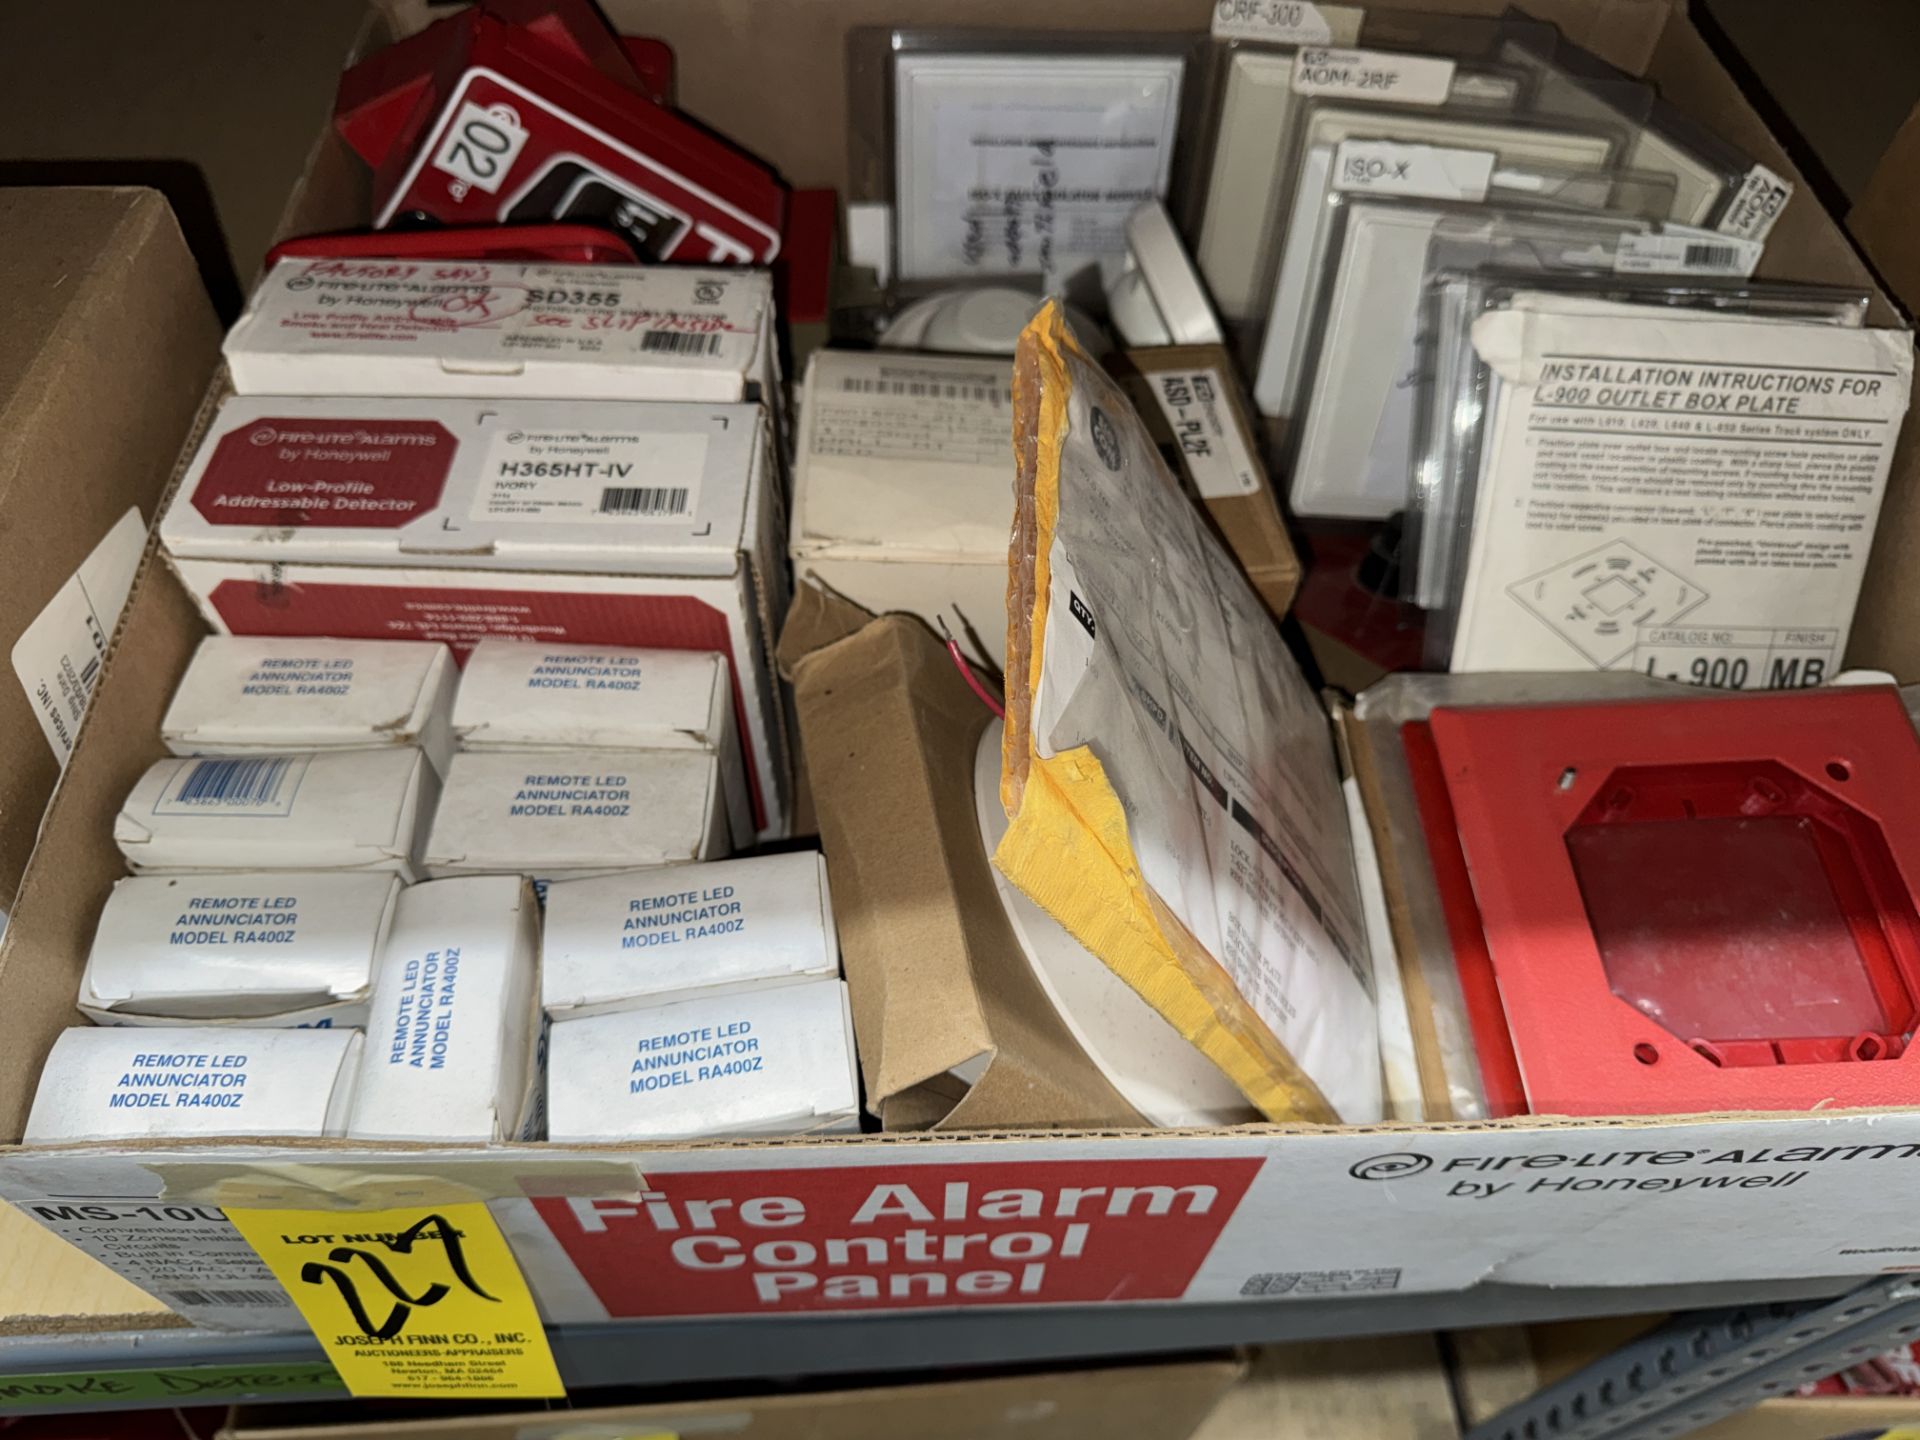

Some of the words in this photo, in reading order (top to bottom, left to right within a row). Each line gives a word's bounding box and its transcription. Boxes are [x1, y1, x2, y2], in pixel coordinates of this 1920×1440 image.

[1344, 156, 1410, 182] ISO-X
[526, 289, 622, 307] SD355
[1539, 363, 1694, 387] INSTALLATION
[1698, 370, 1835, 394] INTRUCTIONS
[1838, 378, 1882, 398] FOR
[1533, 384, 1591, 404] L-900
[1597, 388, 1682, 409] OUTLET
[1684, 392, 1731, 411] BOX
[1735, 395, 1800, 414] PLATE
[279, 448, 301, 462] by
[303, 448, 392, 463] Honeywell
[499, 461, 634, 479] H365HT-IV
[266, 479, 375, 495] Low-Profile
[214, 495, 330, 510] Addressable
[333, 499, 417, 512] Detector
[1650, 630, 1707, 644] CATALOG
[1784, 633, 1826, 645] FINISH
[261, 658, 320, 669] REMOTE
[324, 659, 353, 669] LED
[544, 655, 605, 666] REMOTE
[608, 656, 640, 667] LED
[249, 671, 354, 682] ANNUNCIATOR
[533, 666, 642, 678] ANNUNCIATOR
[1770, 657, 1826, 690] MB
[242, 684, 293, 695] MODEL
[527, 678, 582, 689] MODEL
[524, 774, 591, 786] REMOTE
[595, 775, 627, 787] LED
[515, 789, 630, 801] ANNUNCIATOR
[510, 804, 567, 816] MODEL
[570, 805, 630, 817] RA400Z
[188, 897, 261, 909] REMOTE
[263, 897, 298, 909] LED
[629, 891, 698, 912] REMOTE
[703, 885, 735, 902] LED
[175, 913, 298, 926] ANNUNCIATOR
[623, 901, 742, 931] ANNUNCIATOR
[169, 931, 229, 945] MODEL
[232, 930, 296, 943] RA400Z
[621, 929, 681, 949] MODEL
[685, 918, 745, 941] RA400Z
[439, 947, 461, 1005] RA400Z
[390, 991, 414, 1065] REMOTE
[403, 959, 420, 991] LED
[409, 950, 441, 1069] ANNUNCIATOR
[429, 1009, 453, 1070] MODEL
[638, 1027, 713, 1053] REMOTE
[717, 1021, 752, 1039] LED
[131, 1054, 207, 1069] REMOTE
[210, 1055, 248, 1069] LED
[631, 1038, 760, 1074] ANNUNCIATOR
[117, 1073, 248, 1088] ANNUNCIATOR
[629, 1071, 694, 1095] MODEL
[697, 1056, 764, 1082] RA400Z
[109, 1093, 171, 1108] MODEL
[175, 1093, 244, 1108] RA400Z
[1446, 1179, 1516, 1199] by
[1526, 1170, 1810, 1193] Honeywell
[31, 1205, 231, 1222] MS-10U
[565, 1190, 806, 1233] Fire
[850, 1181, 1219, 1224] Alarm
[78, 1225, 218, 1235] Conventional
[124, 1234, 187, 1243] Zones
[193, 1234, 246, 1243] Initia
[280, 1233, 337, 1245] LOT
[670, 1222, 1090, 1271] Control
[752, 1262, 1046, 1303] Panel
[333, 1334, 404, 1346] JOSEPH
[407, 1333, 450, 1345] FINN
[494, 1332, 532, 1344] INC.
